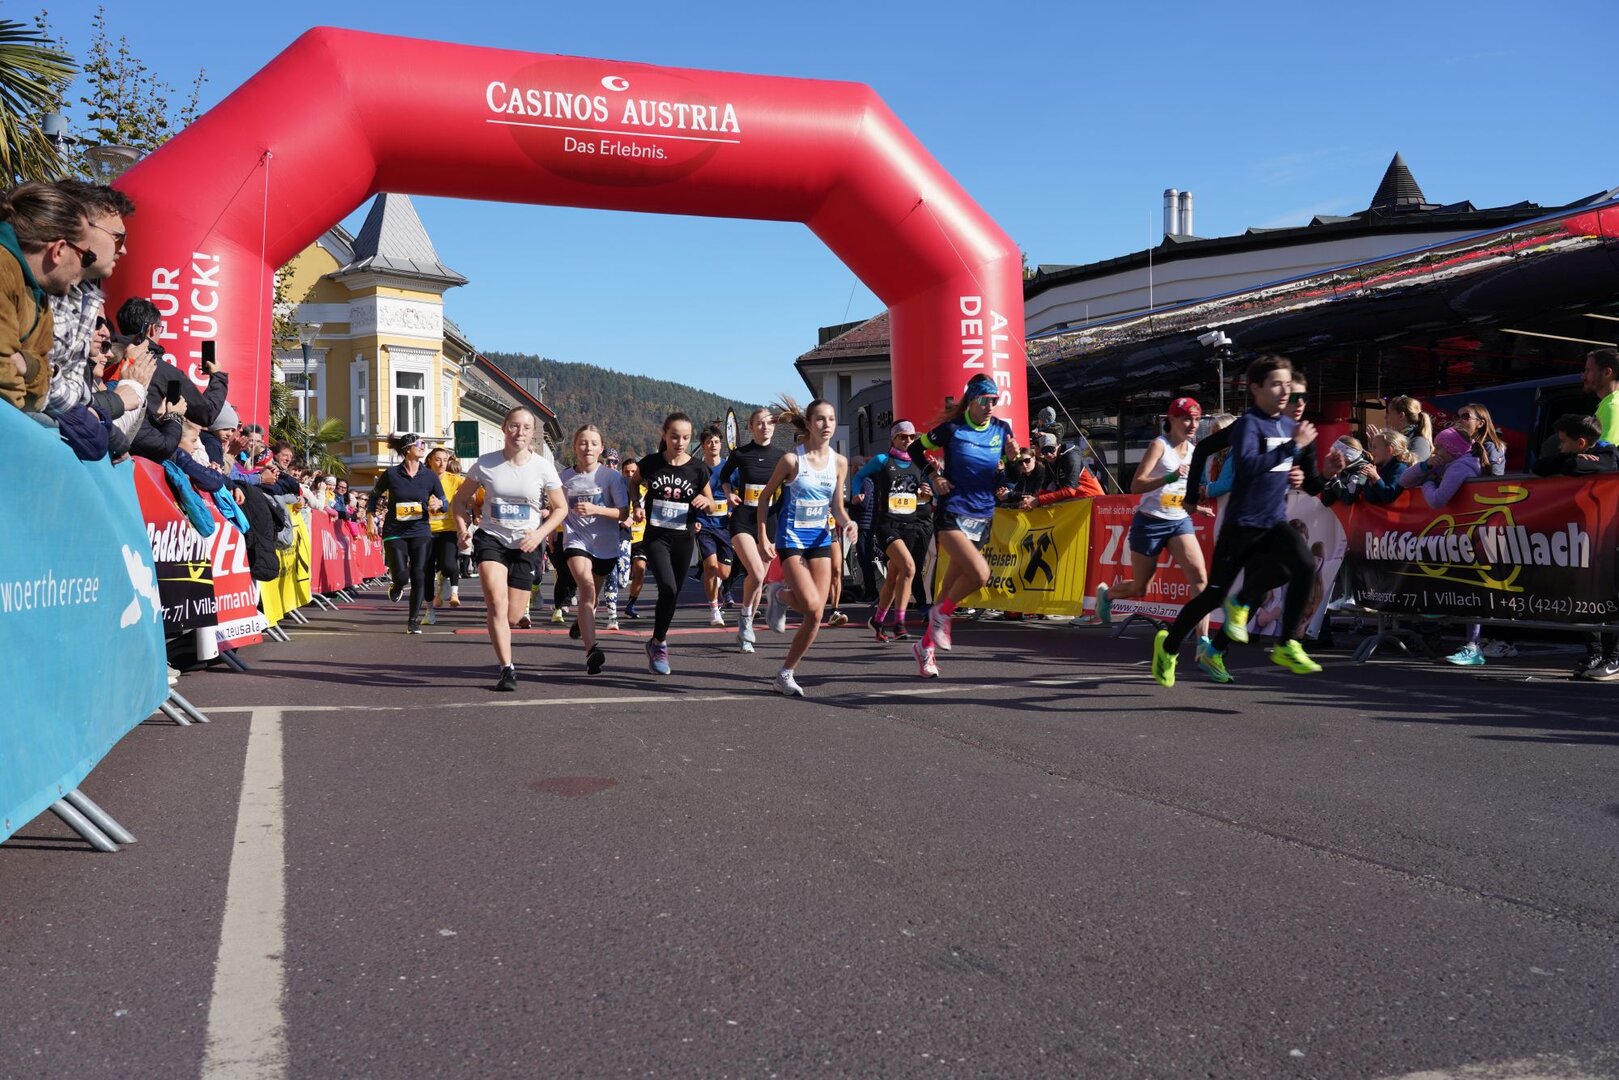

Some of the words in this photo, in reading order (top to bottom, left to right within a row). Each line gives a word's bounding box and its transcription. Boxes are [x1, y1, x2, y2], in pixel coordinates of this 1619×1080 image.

[486, 81, 609, 123] CASINOS
[621, 98, 740, 133] AUSTRIA
[564, 136, 595, 154] Das
[600, 140, 668, 159] Erlebnis.
[959, 296, 985, 369] DEIN
[990, 310, 1011, 407] ALLES
[651, 474, 694, 496] athletic
[664, 486, 682, 499] 36
[500, 504, 520, 514] 686
[661, 508, 678, 518] 561
[805, 507, 823, 516] 644
[1365, 530, 1475, 563] Rad&Service
[1478, 522, 1590, 568] Villach
[0, 568, 99, 613] woerthersee
[1402, 592, 1418, 607] 77
[1434, 592, 1481, 607] Villach
[1500, 597, 1525, 612] +43
[1528, 594, 1573, 616] (4242)
